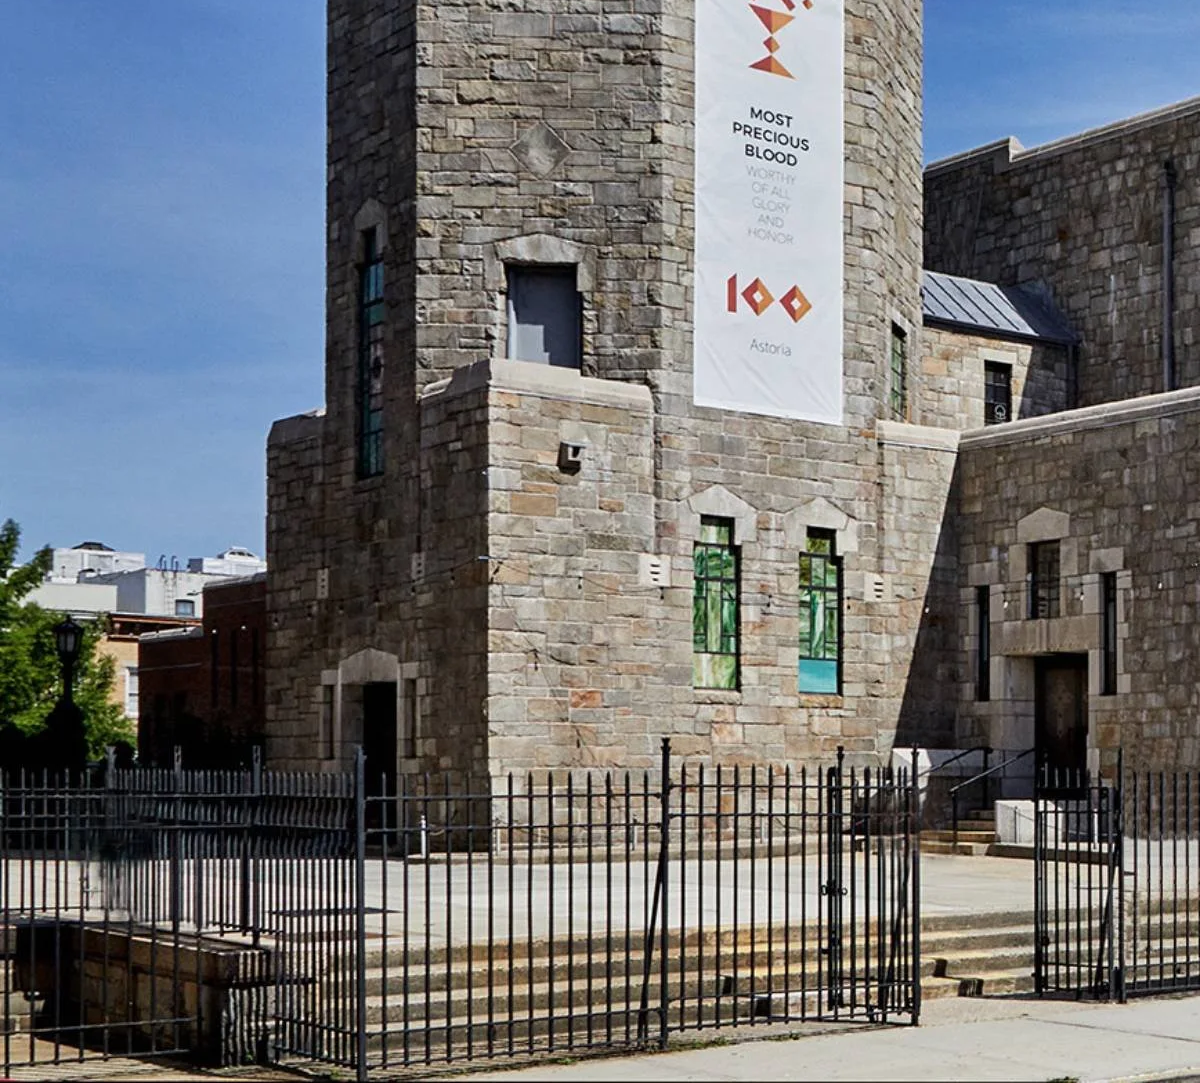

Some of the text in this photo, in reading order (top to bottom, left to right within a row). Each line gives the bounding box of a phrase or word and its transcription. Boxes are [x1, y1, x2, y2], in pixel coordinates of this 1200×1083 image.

[750, 106, 793, 128] MOST
[732, 121, 809, 151] PRECIOUS
[745, 143, 797, 166] BLOOD
[745, 165, 796, 185] WORTHY
[751, 181, 791, 200] OF ALL
[752, 196, 791, 213] GLORY
[758, 214, 784, 229] AND
[747, 227, 794, 244] HONOR
[727, 272, 812, 323] 100
[750, 338, 792, 356] Astoria
